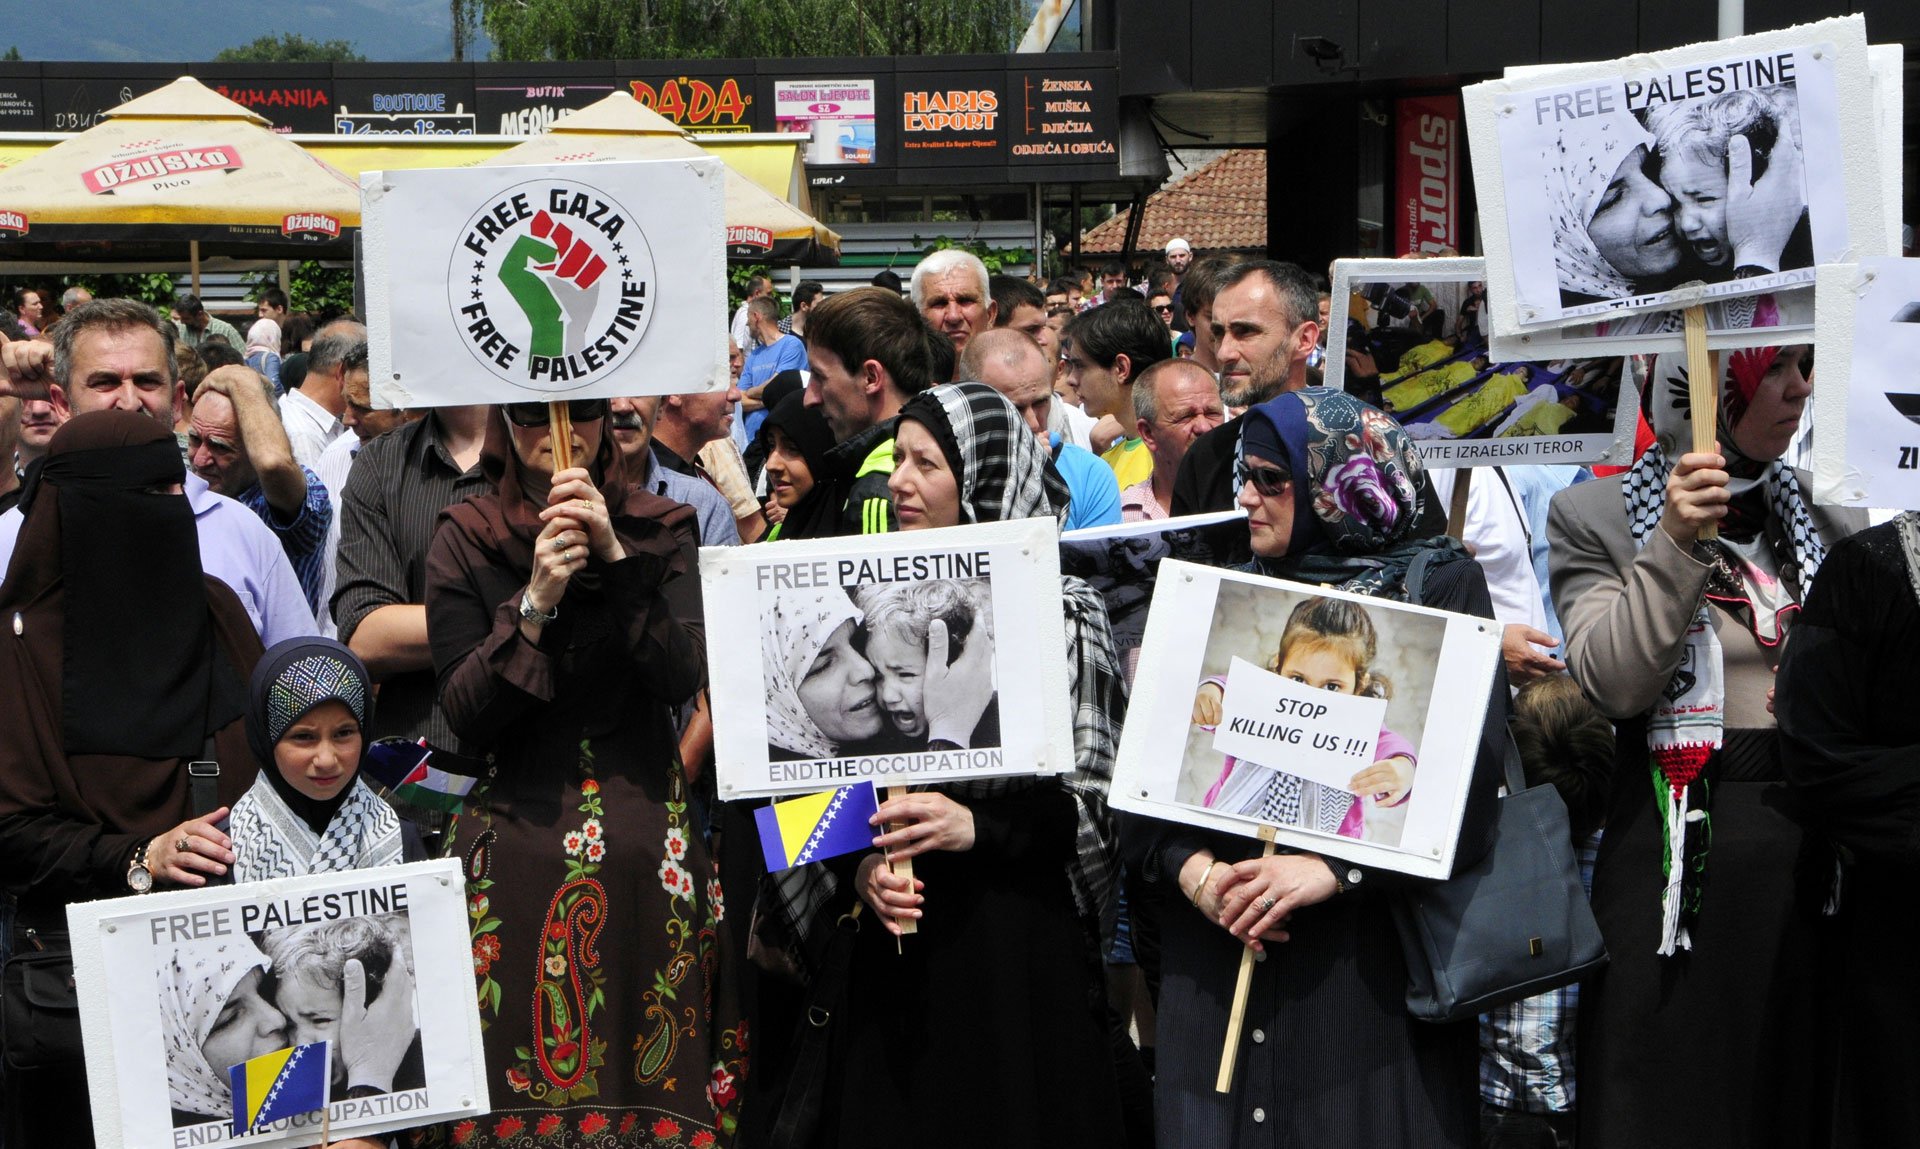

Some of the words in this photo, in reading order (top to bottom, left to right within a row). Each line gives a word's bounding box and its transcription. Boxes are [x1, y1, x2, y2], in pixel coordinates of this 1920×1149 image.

[526, 87, 565, 98] BUTIK
[1042, 79, 1092, 92] ŽENSKA
[1535, 84, 1615, 126] FREE
[1625, 53, 1797, 110] PALESTINE
[373, 94, 446, 112] BOUTIQUE
[778, 90, 817, 102] SALON
[820, 89, 871, 101] LJEPOTE
[904, 90, 998, 112] HARIS
[1045, 99, 1091, 112] MUŠKA
[904, 112, 998, 131] EXPORT
[1042, 120, 1093, 133] DJEČIJA
[1012, 142, 1063, 155] ODJEĆA
[1064, 143, 1070, 154] I
[1071, 141, 1115, 154] OBUĆA
[94, 151, 230, 188] Ožujsko
[152, 179, 191, 191] Pivo
[287, 214, 336, 232] Ožujsko
[464, 192, 533, 257] FREE
[549, 188, 625, 242] GAZA
[726, 226, 768, 244] žujsko
[461, 300, 521, 370] FREE
[529, 281, 646, 382] PALESTINE
[1456, 443, 1529, 458] IZRAELSKI
[1534, 440, 1583, 454] TEROR
[756, 561, 829, 590] FREE
[838, 551, 991, 586] PALESTINE
[1275, 694, 1327, 720] STOP
[1229, 716, 1304, 746] KILLING
[1312, 732, 1339, 752] US
[1343, 738, 1369, 758] !!!
[150, 908, 232, 945] FREE
[241, 883, 409, 932] PALESTINE
